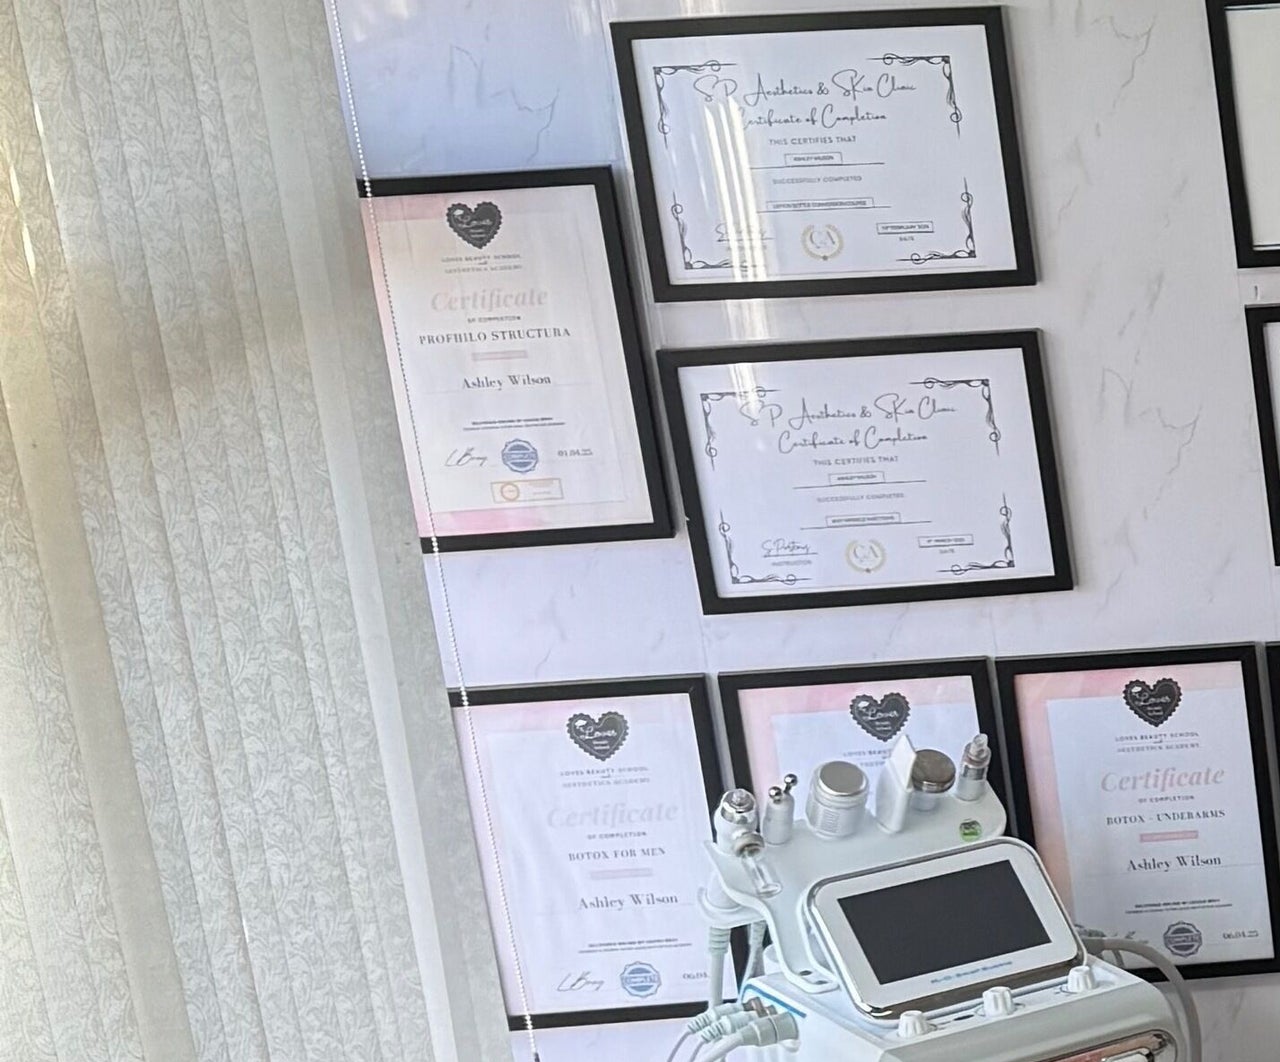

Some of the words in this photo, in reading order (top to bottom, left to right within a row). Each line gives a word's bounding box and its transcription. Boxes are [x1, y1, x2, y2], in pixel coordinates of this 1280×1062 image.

[744, 73, 813, 107] Aesthetics
[877, 73, 917, 99] Clinic
[805, 109, 818, 124] of
[821, 103, 887, 128] Completion
[431, 288, 548, 313] Certificate
[419, 332, 487, 345] PROFHILO
[491, 328, 571, 342] STRUCTURA
[462, 376, 503, 391] Ashley
[508, 374, 551, 385] Wilson
[788, 397, 857, 430] Aesthetics
[918, 396, 956, 420] Clinic
[778, 430, 844, 454] Certificate
[848, 431, 860, 447] of
[863, 425, 928, 449] Completion
[1100, 767, 1225, 793] Certificate
[1149, 794, 1195, 803] COMPLETION
[546, 802, 680, 829] Certificate
[1106, 815, 1146, 826] BOTOX
[1157, 810, 1226, 822] UNDERARMS
[568, 850, 609, 862] BOTOX
[614, 849, 637, 858] FOR
[641, 847, 666, 858] MEN
[1126, 859, 1171, 872] Ashley
[1176, 855, 1222, 867] Wilson
[577, 897, 625, 911] Ashley
[629, 893, 679, 906] Wilson
